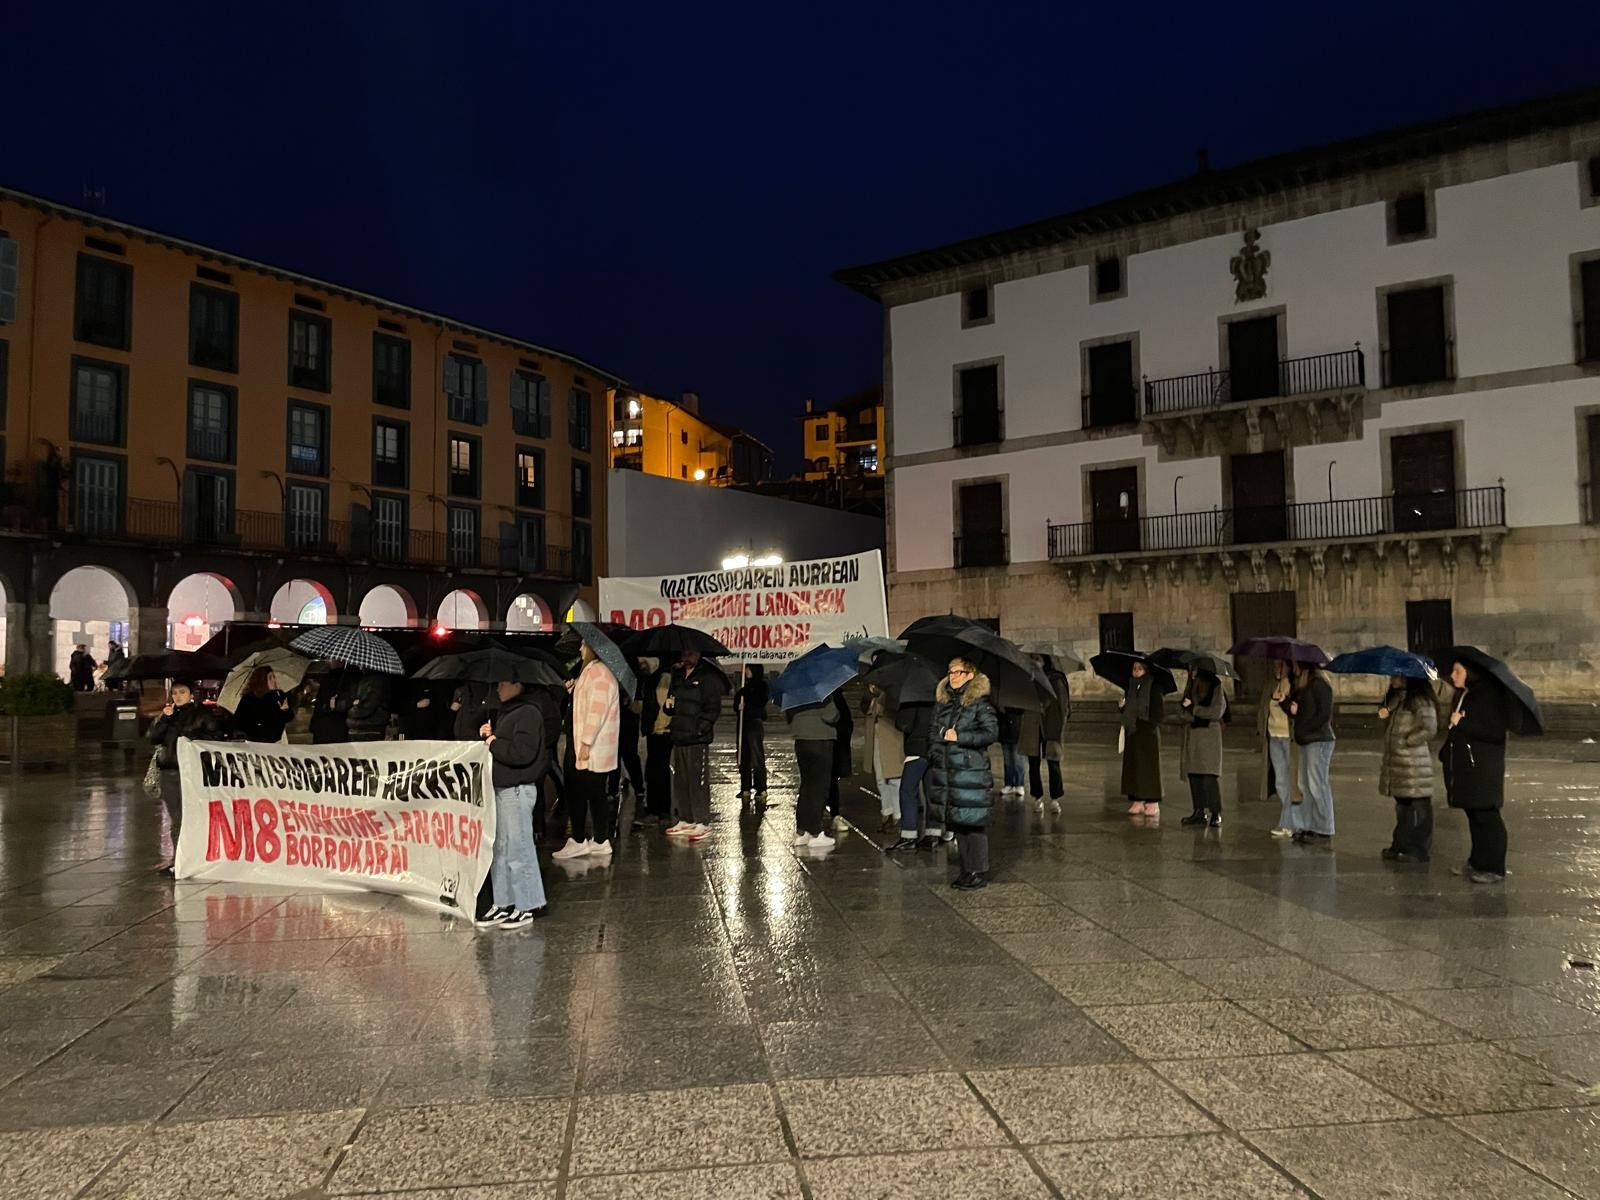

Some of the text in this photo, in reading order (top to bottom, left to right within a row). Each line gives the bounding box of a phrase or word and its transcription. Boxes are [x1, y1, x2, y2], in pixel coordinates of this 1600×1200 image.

[789, 558, 859, 587] AURREAN
[206, 798, 281, 863] M8
[278, 800, 389, 840] EMAKUME
